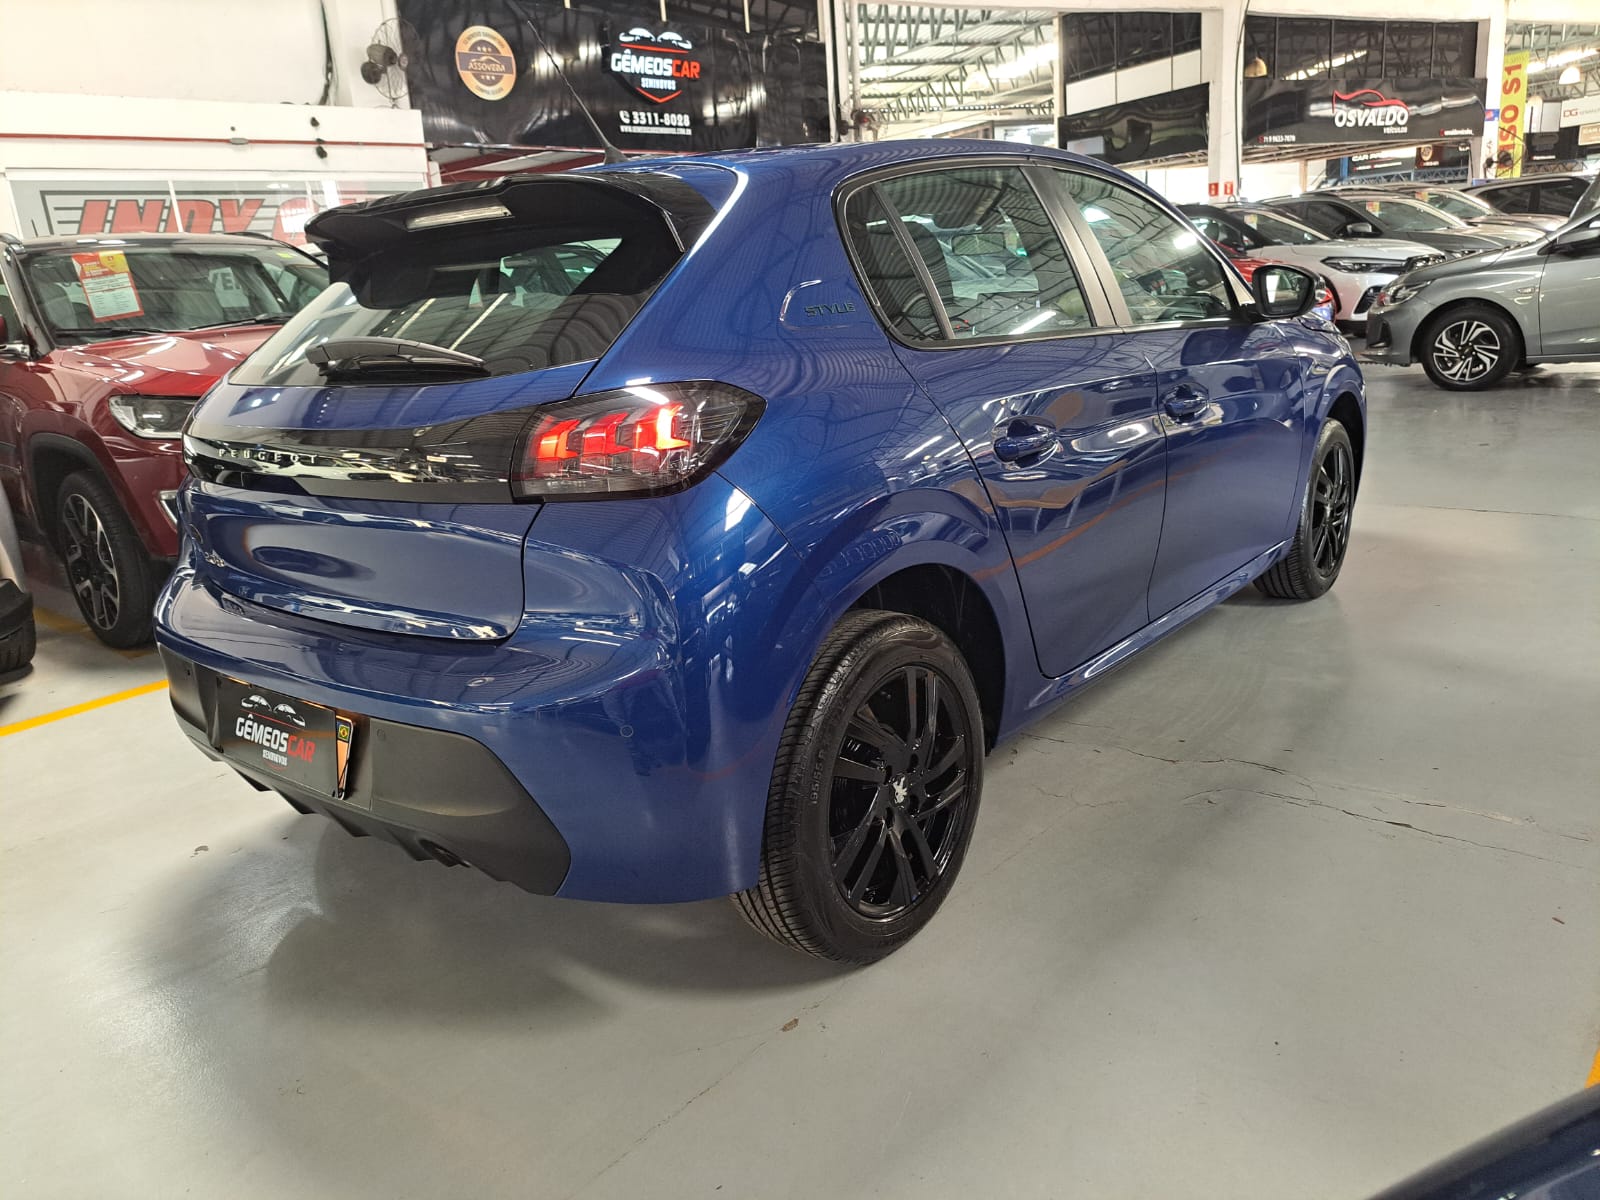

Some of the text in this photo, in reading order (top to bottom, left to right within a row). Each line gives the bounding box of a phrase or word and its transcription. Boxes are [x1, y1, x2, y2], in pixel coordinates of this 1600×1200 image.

[610, 49, 701, 79] GÊMEOSCAR
[632, 111, 690, 127] 3311-8028
[1334, 107, 1409, 128] OSVALDO
[804, 302, 857, 317] STYLE
[218, 448, 318, 464] PEUGEOT
[235, 713, 316, 763] GÊMEOSCAR
